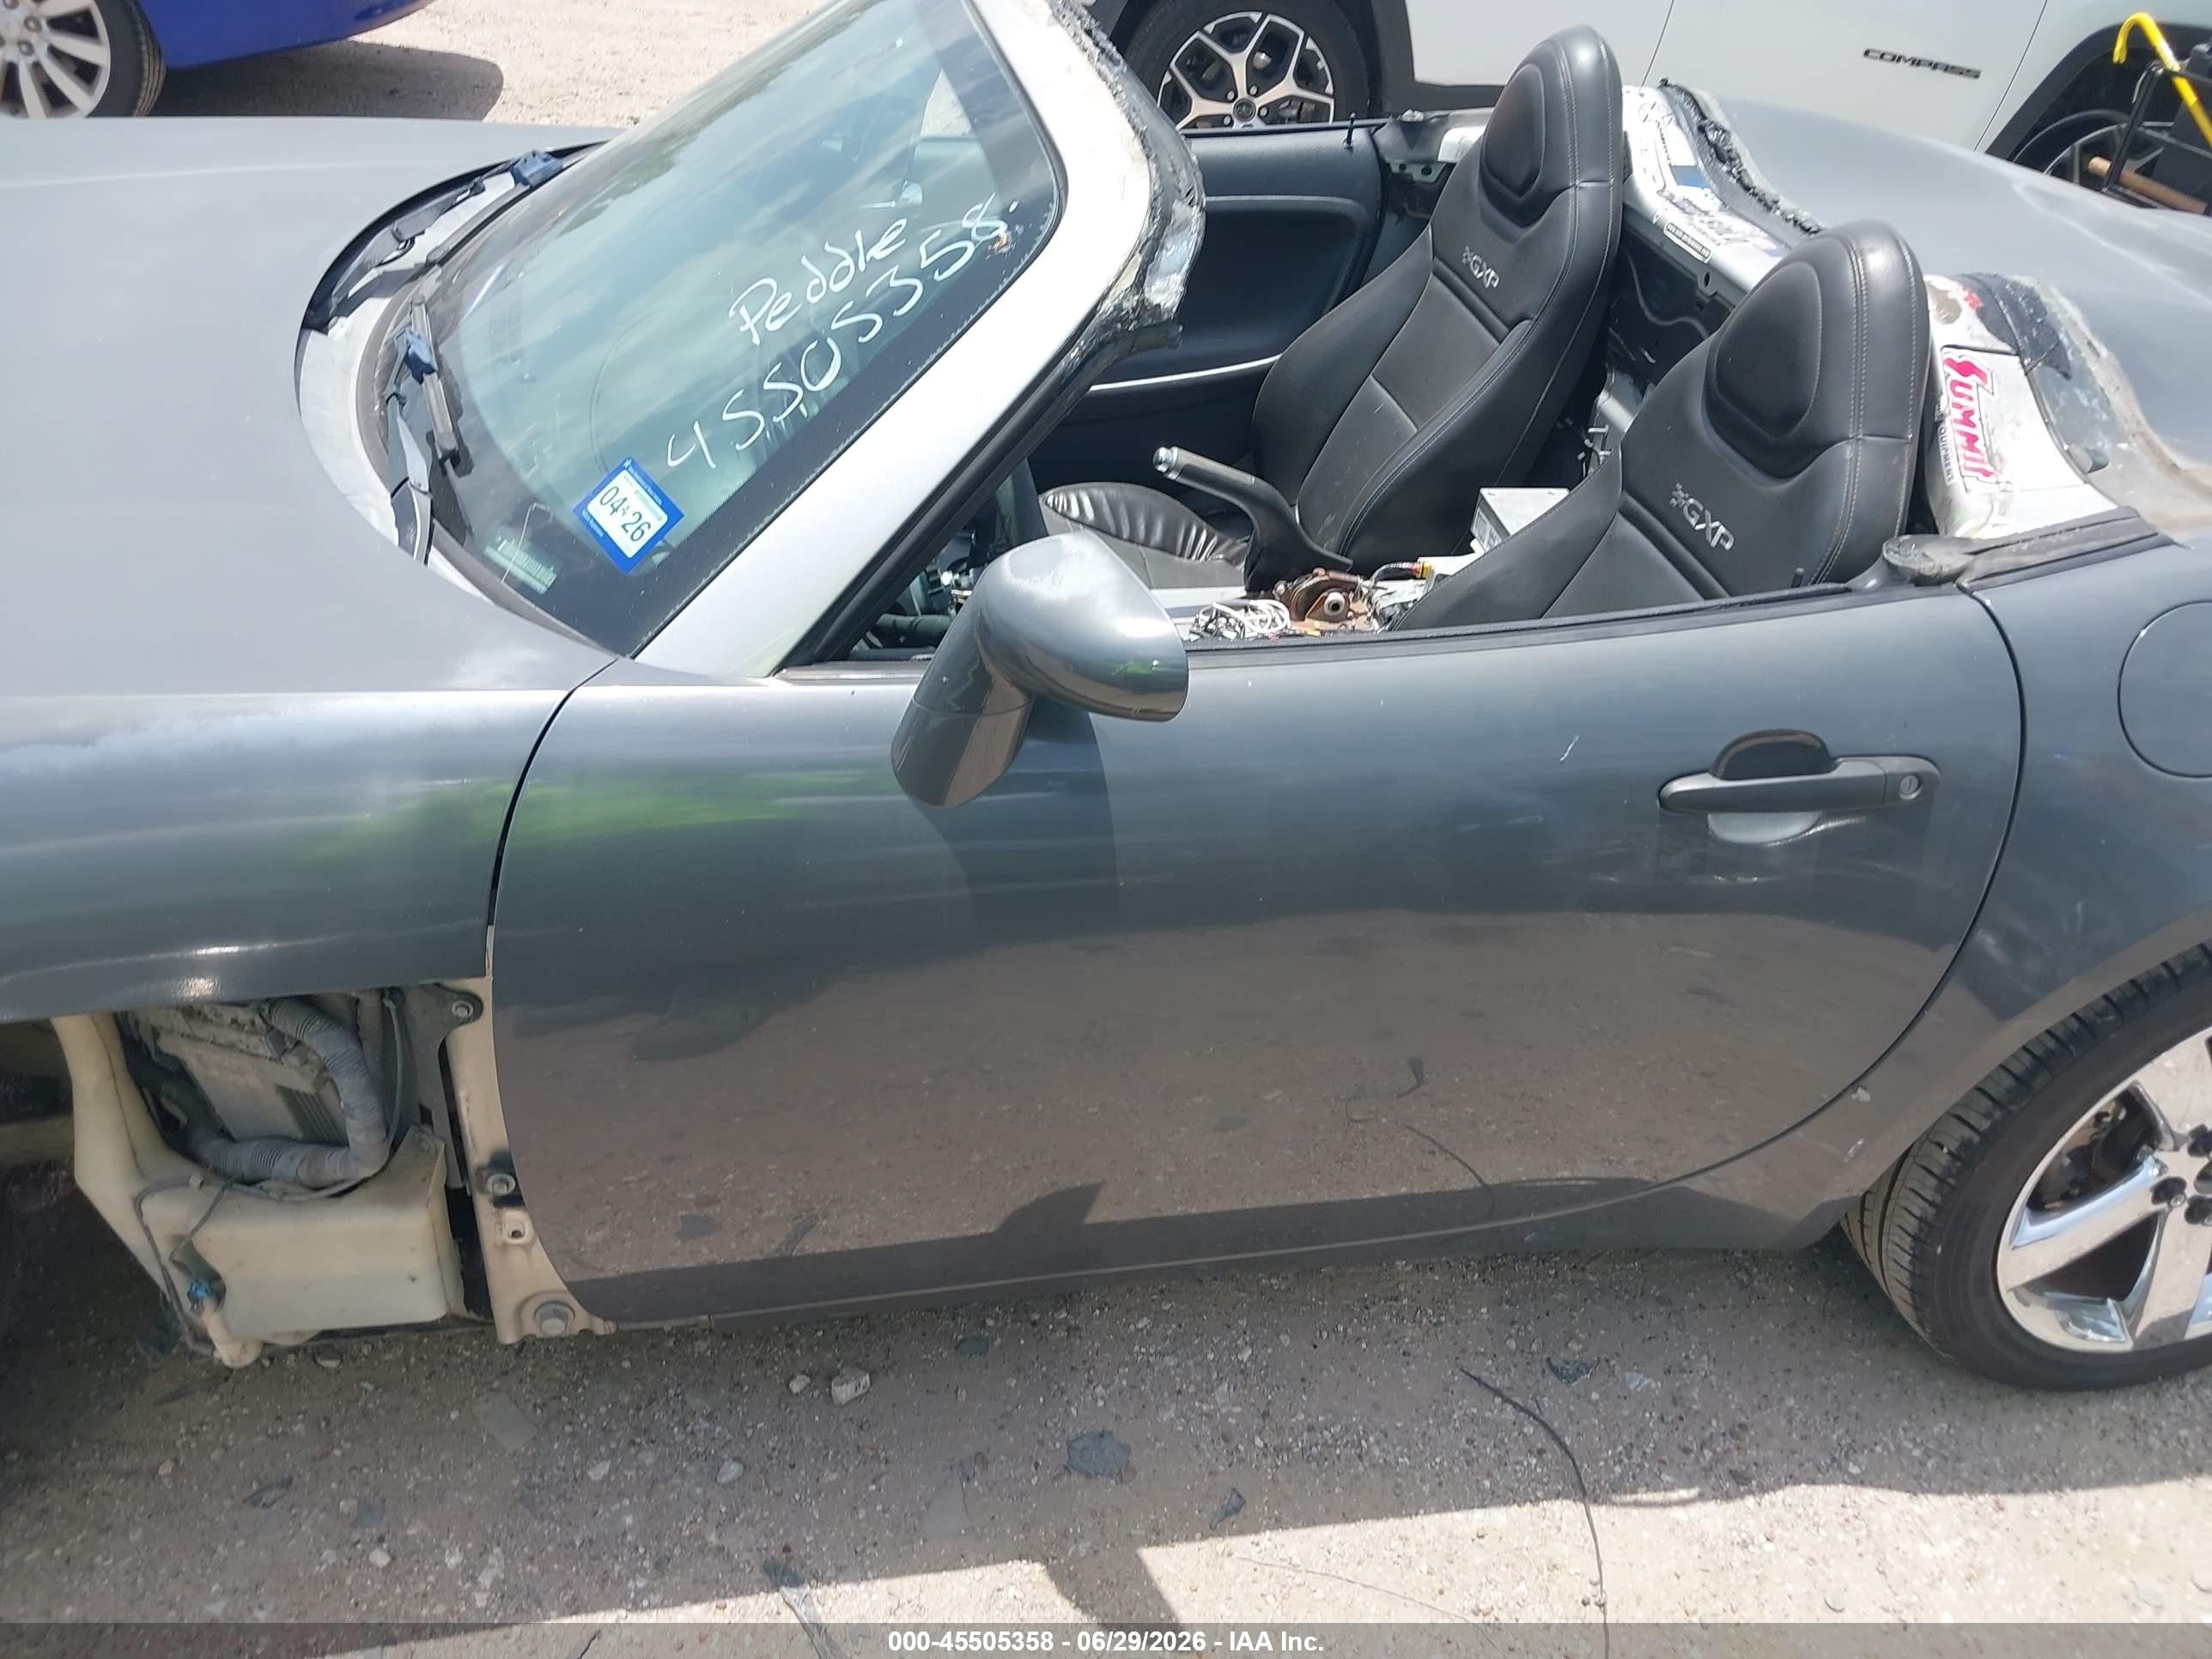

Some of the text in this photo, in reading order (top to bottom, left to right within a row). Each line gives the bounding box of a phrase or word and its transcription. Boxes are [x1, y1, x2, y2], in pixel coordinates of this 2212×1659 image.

[1863, 47, 1982, 80] COMPASS
[728, 217, 908, 346] Peddle
[1469, 253, 1501, 289] GXP
[666, 191, 1008, 469] 45505358
[1682, 497, 1735, 550] GXP
